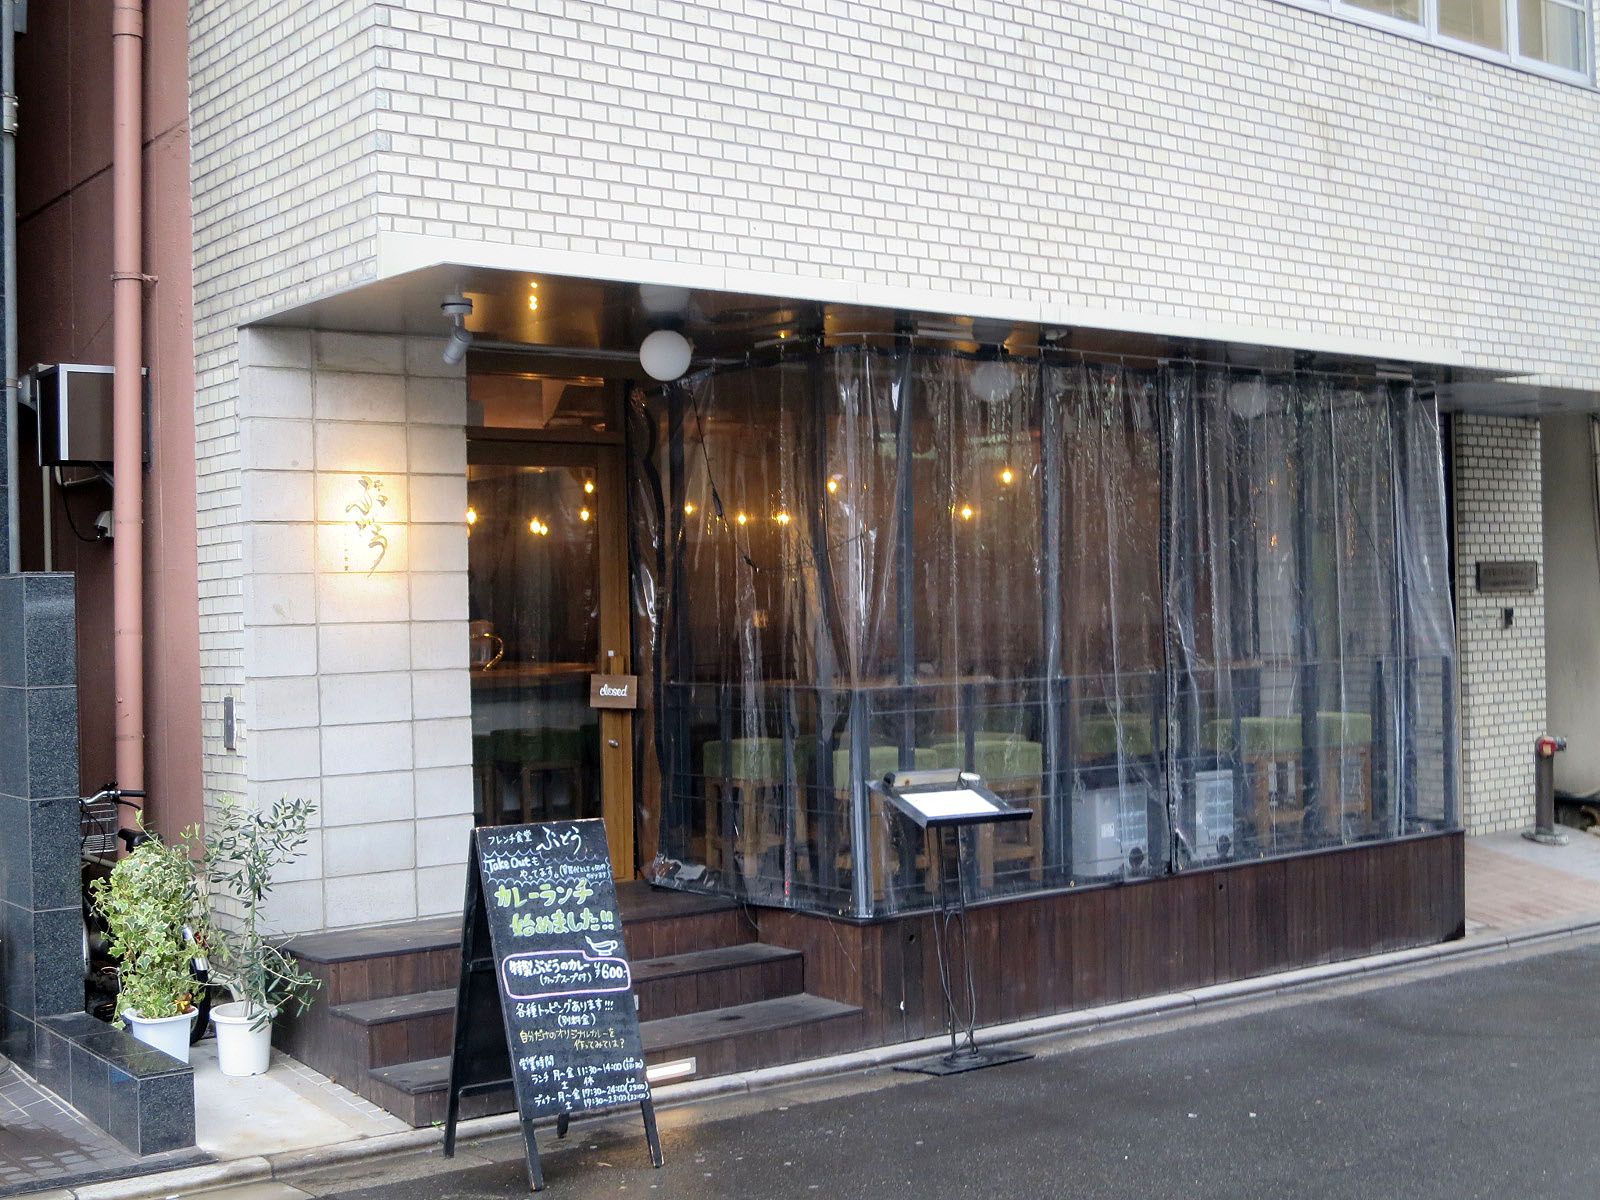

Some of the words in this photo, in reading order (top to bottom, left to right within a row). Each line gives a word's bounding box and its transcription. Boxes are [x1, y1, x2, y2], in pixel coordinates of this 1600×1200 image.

[599, 683, 628, 697] closed
[488, 829, 533, 845] フレンチ食堂
[536, 826, 582, 855] ぶどう
[485, 857, 509, 873] Take
[494, 880, 594, 907] カレーランチ
[509, 958, 591, 977] 特製ぶどうのカレー
[519, 1027, 615, 1044] 自分だけのオリジナルカレーを
[519, 1054, 554, 1072] 営業時間
[531, 1072, 549, 1085] ランチ
[534, 1094, 556, 1107] ディナー
